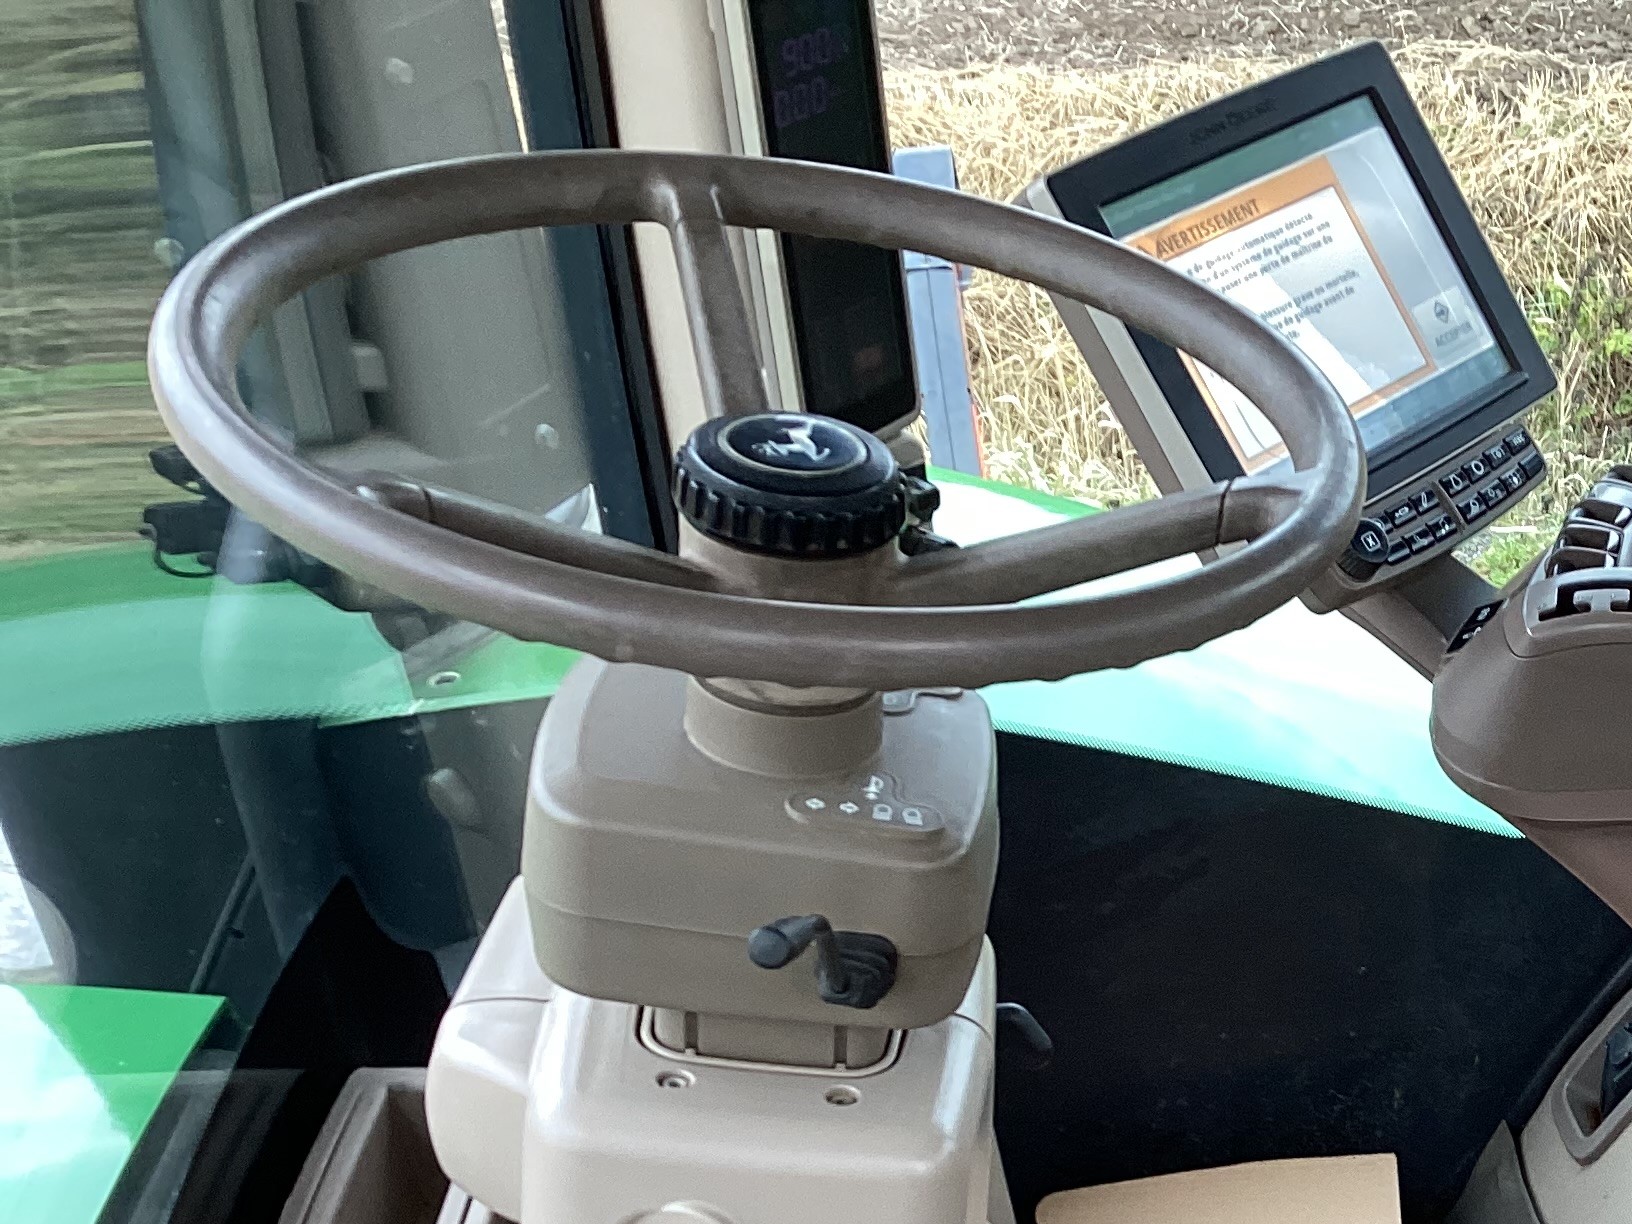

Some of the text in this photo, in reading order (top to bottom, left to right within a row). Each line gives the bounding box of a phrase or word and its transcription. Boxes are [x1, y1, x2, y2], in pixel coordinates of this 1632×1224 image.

[1155, 199, 1262, 258] AVERTISSEMENT
[1273, 234, 1302, 255] guidage
[1303, 228, 1314, 238] sur
[1316, 222, 1330, 232] une
